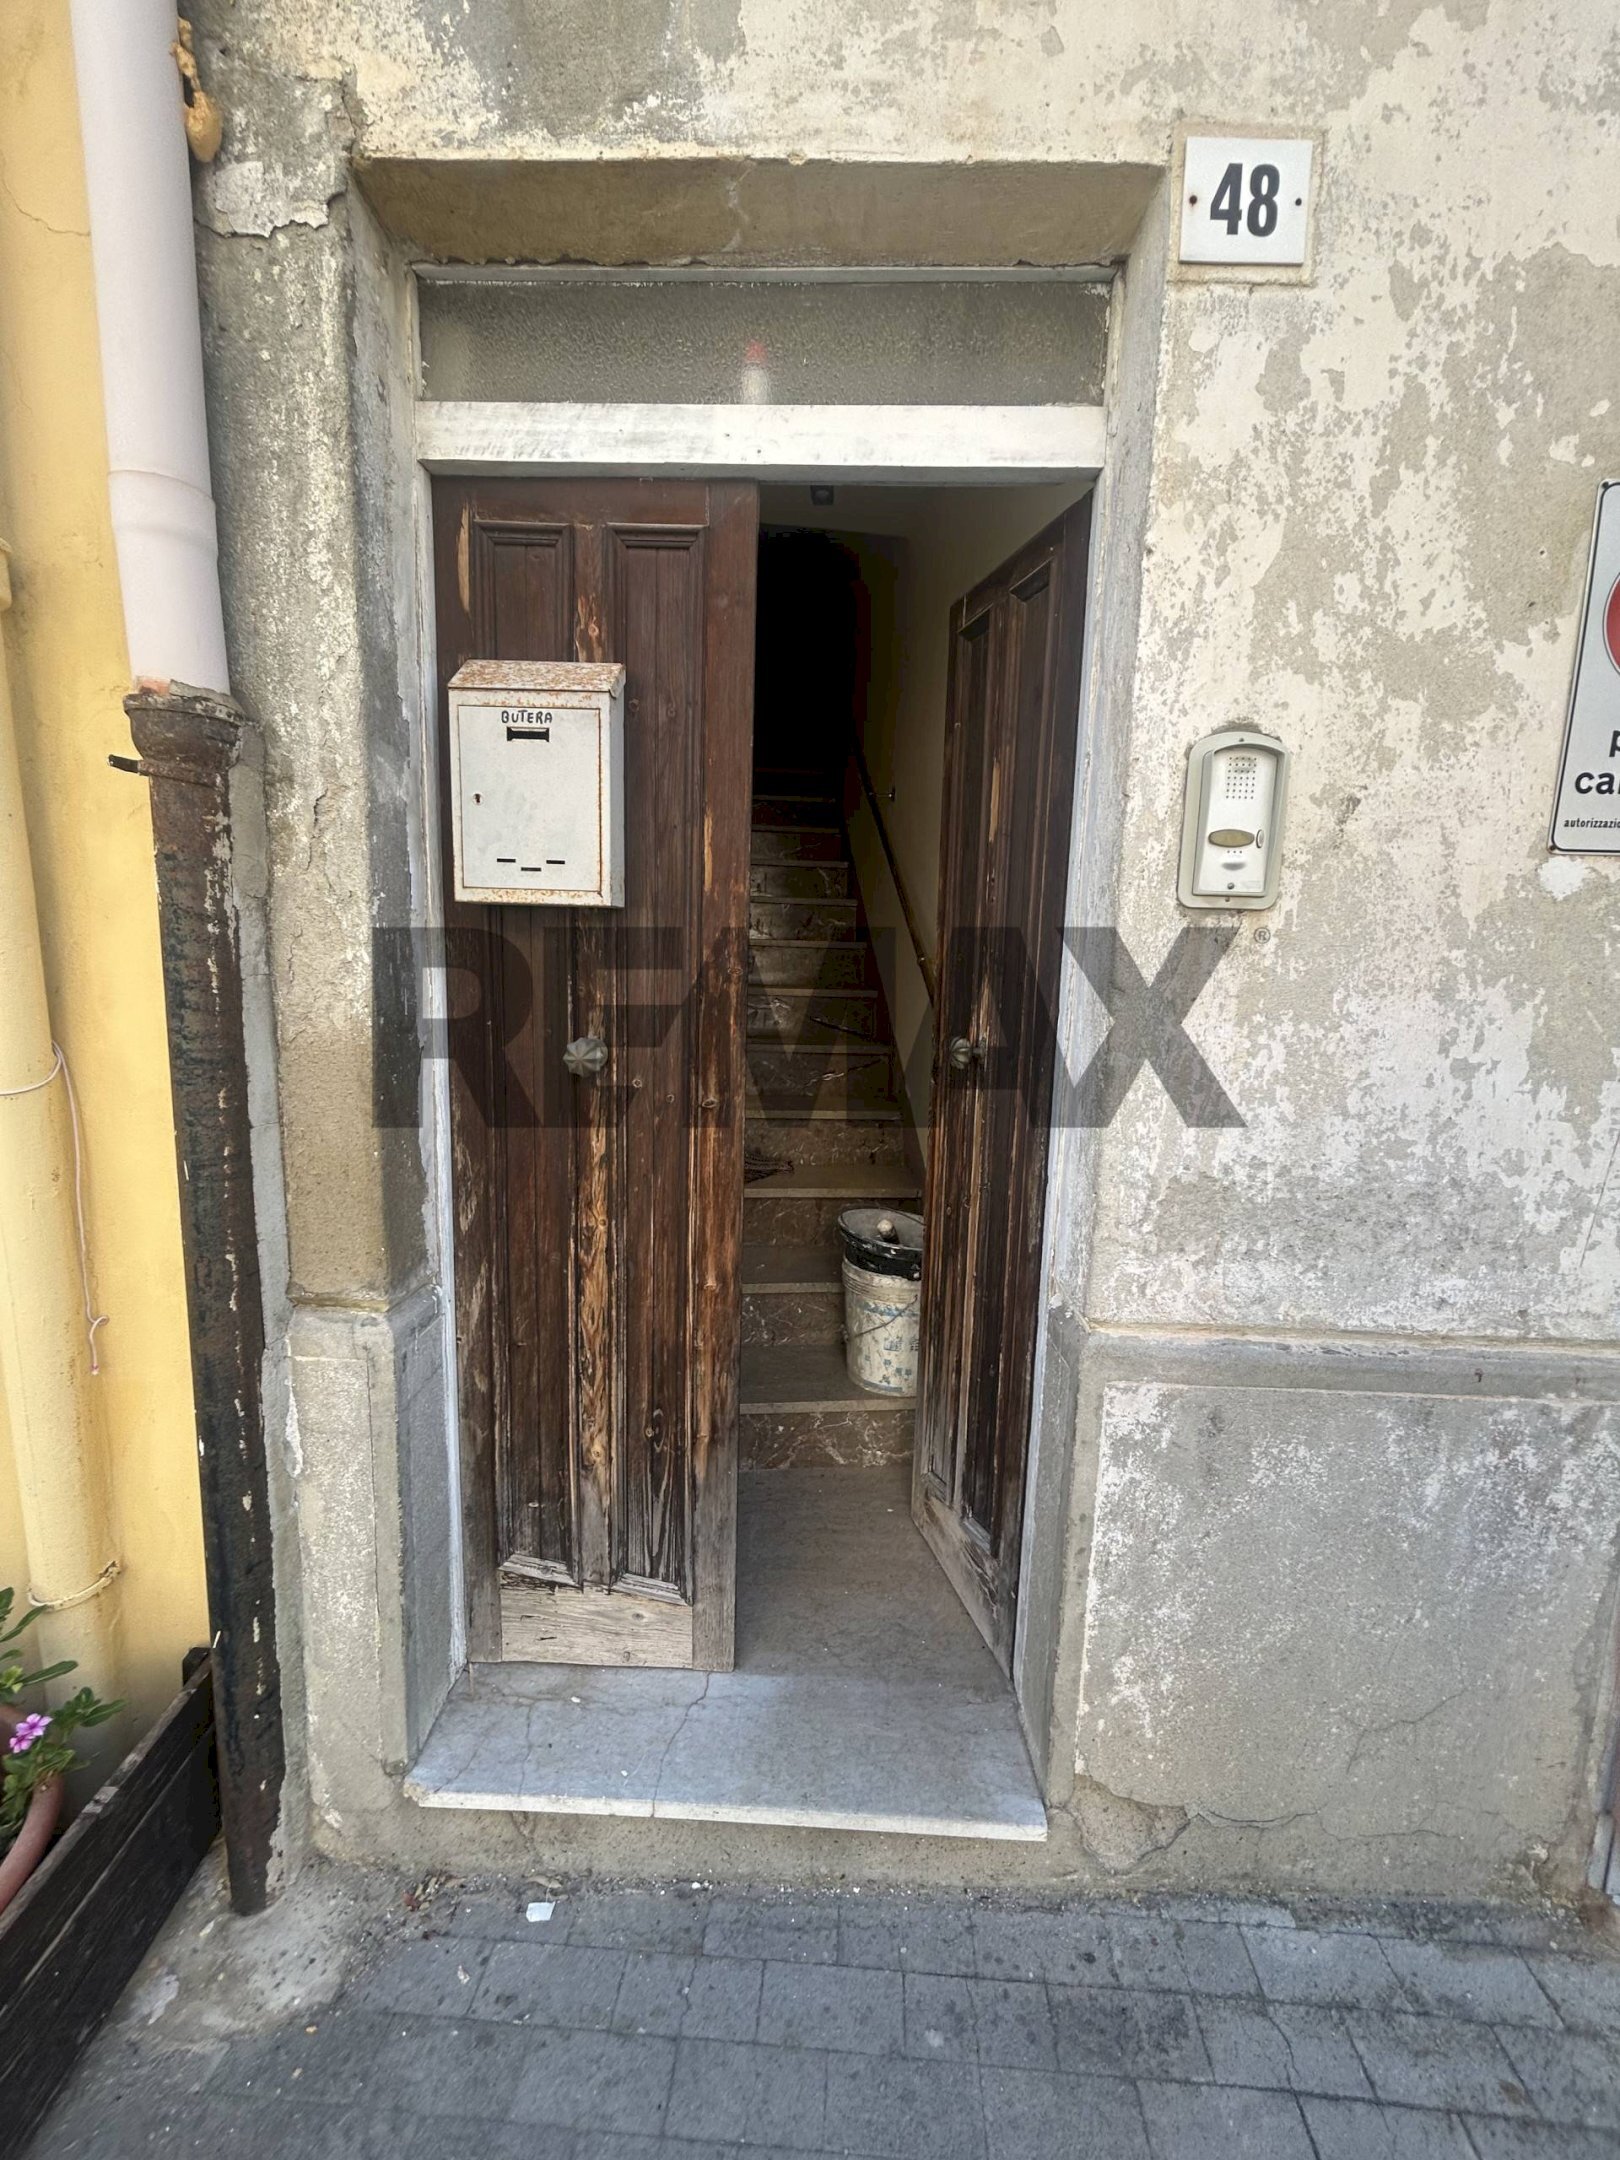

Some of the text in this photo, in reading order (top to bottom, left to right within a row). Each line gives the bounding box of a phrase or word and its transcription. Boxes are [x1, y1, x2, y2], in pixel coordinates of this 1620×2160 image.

[1210, 163, 1280, 237] 48
[501, 710, 553, 724] BUTERA
[1575, 772, 1620, 794] ca
